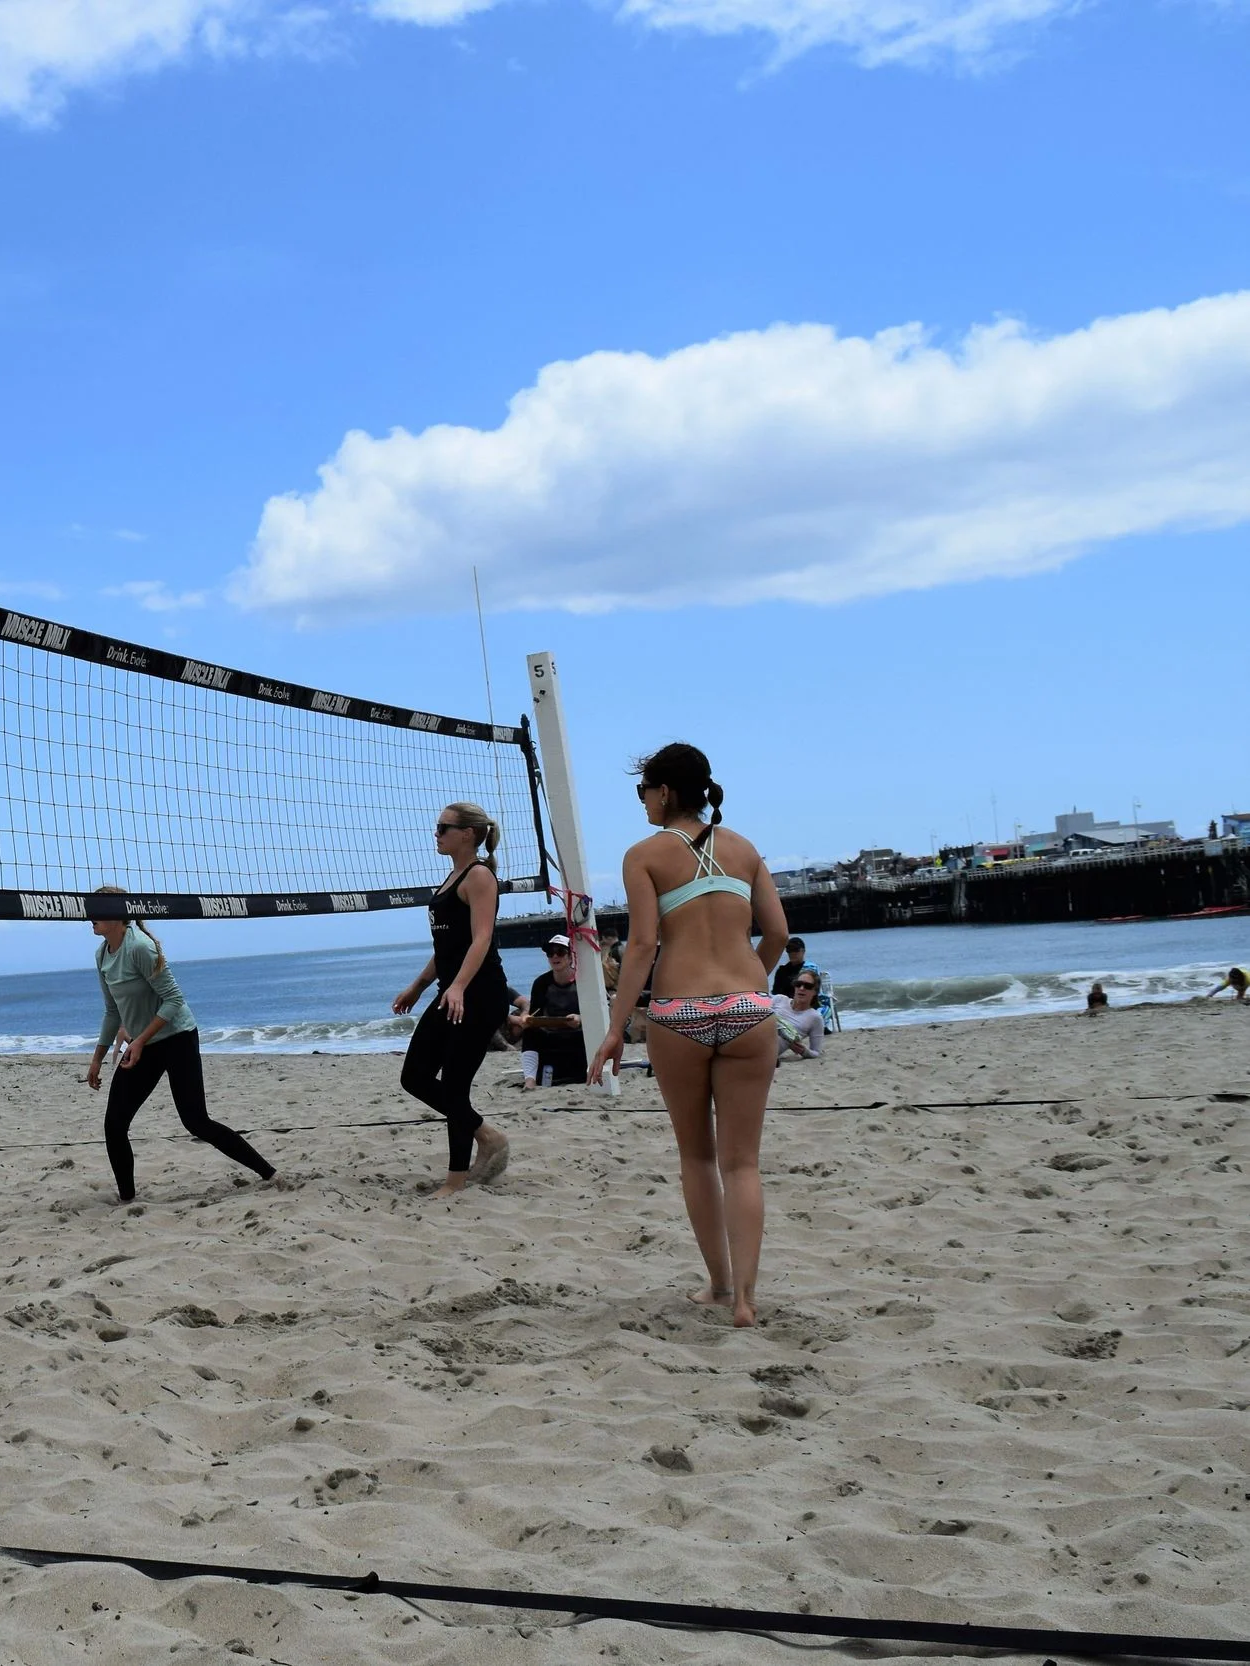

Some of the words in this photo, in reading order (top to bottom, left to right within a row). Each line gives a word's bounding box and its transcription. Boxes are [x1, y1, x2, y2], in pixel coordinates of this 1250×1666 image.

[1, 613, 46, 645] MUSCLE
[42, 623, 72, 650] MILK
[180, 660, 214, 686] MUSCLE
[533, 664, 545, 678] 5
[19, 893, 62, 918] MUSCLE
[61, 895, 88, 918] MILK
[198, 896, 230, 917] MUSCLE
[227, 896, 249, 916] MILK
